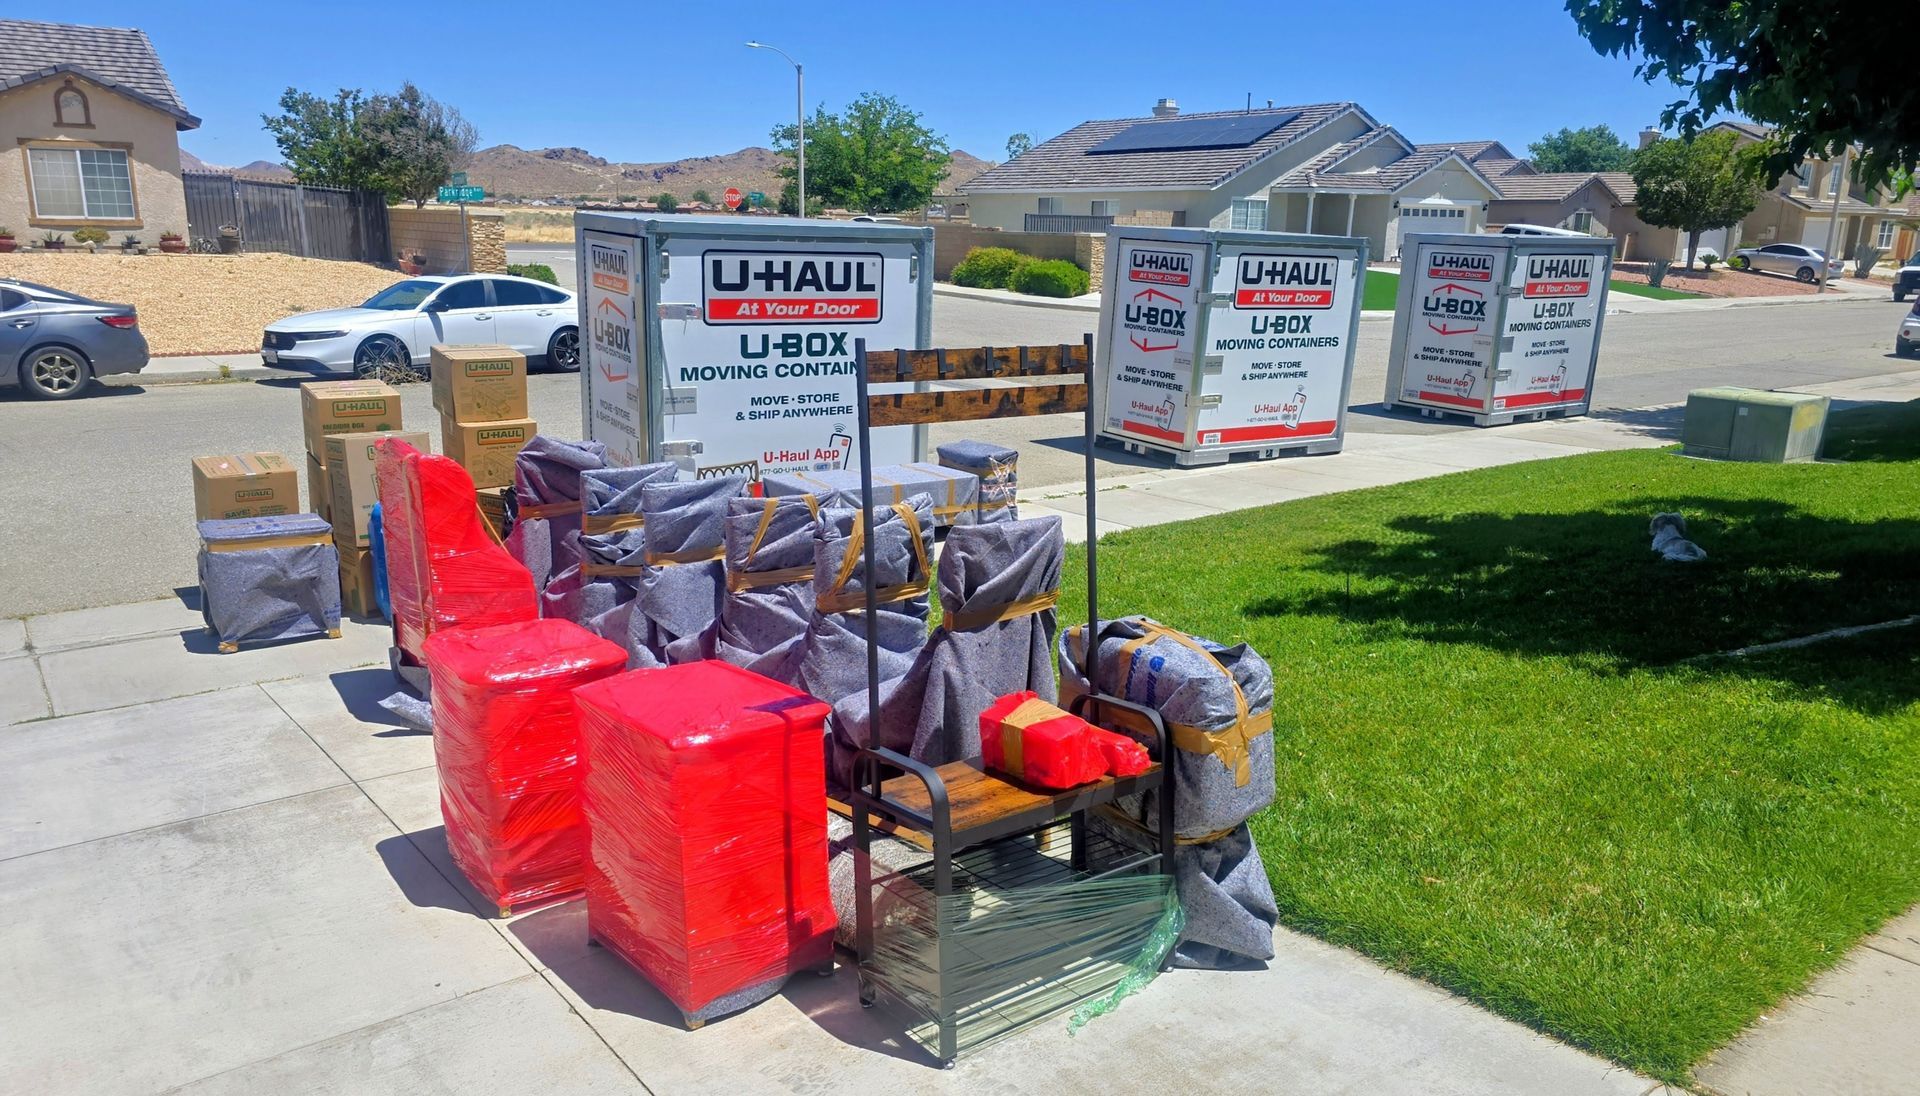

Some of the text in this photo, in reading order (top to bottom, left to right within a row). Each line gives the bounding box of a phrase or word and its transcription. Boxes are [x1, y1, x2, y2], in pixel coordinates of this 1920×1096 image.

[725, 194, 740, 202] STOP
[593, 250, 627, 275] U-HAUL
[1132, 254, 1189, 272] U-HAUL
[1432, 255, 1490, 270] U-HAUL
[1529, 259, 1590, 279] U-HAUL
[712, 259, 876, 293] U-HAUL
[1164, 274, 1182, 282] Door
[1242, 260, 1332, 286] U-HAUL
[1536, 284, 1582, 293] At Your Door
[1252, 292, 1322, 303] At Your Door
[737, 302, 860, 316] At Your Door
[1424, 296, 1488, 317] U-BOX
[1533, 302, 1575, 319] U-BOX
[1125, 304, 1187, 330] U-BOX
[1422, 311, 1486, 322] MOVING CONTAINERS
[1124, 322, 1186, 337] MOVING CONTAINERS
[1251, 315, 1313, 335] U-BOX
[1509, 318, 1592, 332] MOVING CONTAINERS
[594, 317, 631, 354] U-BOX
[740, 332, 849, 359] U-BOX
[1216, 336, 1340, 351] MOVING CONTAINERS
[1531, 340, 1547, 348] MOVE
[1422, 346, 1475, 358] MOVE STORE
[1542, 348, 1570, 356] ANYWHERE
[468, 362, 511, 372] U-HAUL
[1251, 360, 1302, 370] MOVE STORE
[1439, 356, 1483, 368] ANYWHERE
[680, 361, 857, 382] MOVING CONTAIN
[1125, 365, 1176, 380] MOVE STORE
[1241, 370, 1309, 381] & SHIP ANYWHERE
[1124, 374, 1141, 384] SHIP
[1141, 378, 1184, 392] ANYWHERE
[1426, 374, 1452, 385] U-Haul
[1453, 378, 1469, 388] App
[336, 400, 384, 412] U-HAUL
[750, 392, 840, 406] MOVE STORE
[735, 405, 854, 421] & SHIP ANYWHERE
[1131, 400, 1154, 412] U-Haul
[1154, 405, 1169, 416] App
[1254, 403, 1298, 414] U-Haul App
[480, 430, 522, 440] U-HAUL
[764, 448, 840, 464] U-Haul App
[238, 490, 272, 498] U-HAUL
[224, 508, 251, 519] SAVE!
